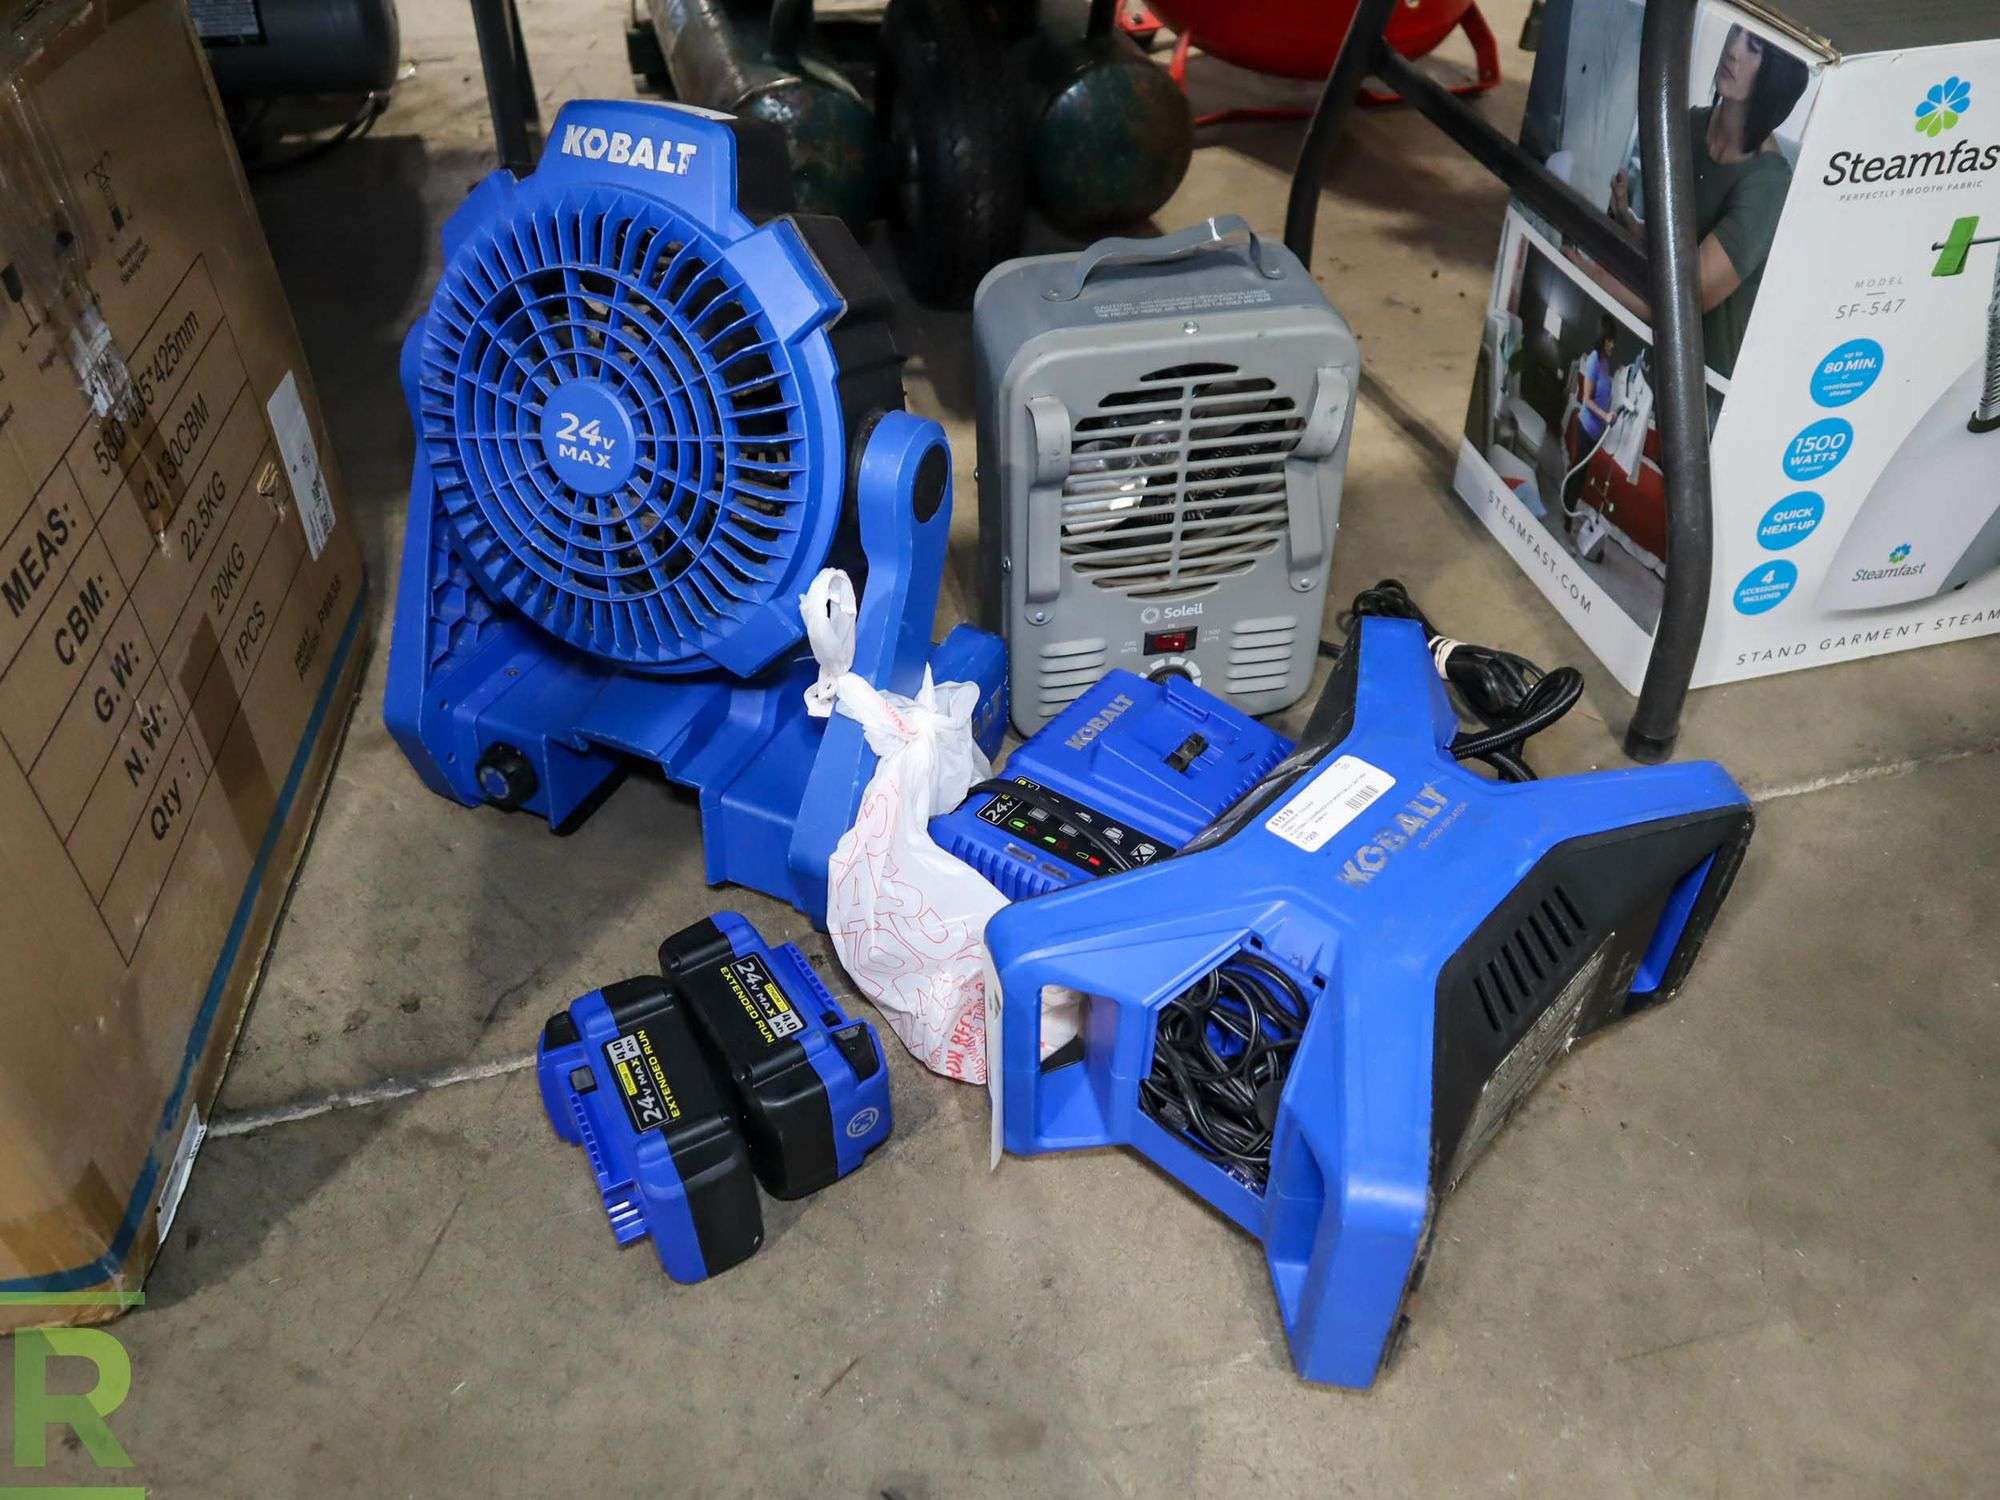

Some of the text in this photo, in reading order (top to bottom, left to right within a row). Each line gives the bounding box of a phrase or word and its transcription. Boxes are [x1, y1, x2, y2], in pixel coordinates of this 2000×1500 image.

[561, 124, 697, 175] KOBALT
[1839, 180, 1984, 202] PERFECTLY SMOOTH FABRIC
[1855, 277, 1904, 289] MODEL
[1835, 299, 1906, 319] SF-547
[1823, 357, 1877, 374] 80 MIN.
[1795, 433, 1846, 454] 1500
[559, 444, 612, 469] MAX
[1791, 452, 1838, 466] WATTS
[180, 470, 226, 561] 22.5KG
[1773, 507, 1815, 522] QUICK
[1761, 520, 1816, 536] HEAT-UP
[1, 503, 77, 618] MEAS:
[1488, 490, 1593, 614] STEAMFAST.COM
[211, 542, 245, 616] 20KG
[1761, 569, 1775, 583] 4
[1852, 562, 1926, 582] Steamfast
[54, 576, 110, 666] CBM:
[1163, 603, 1204, 619] Soleil
[233, 601, 267, 671] 1PCS
[1736, 643, 1806, 666] STAND
[1820, 622, 1923, 650] GARMENT
[1063, 693, 1135, 752] KOBALT
[1337, 784, 1449, 888] KOBALT
[720, 966, 776, 1043] EXTENDED RUN
[756, 993, 777, 1017] MAX
[782, 1013, 797, 1031] 4.0
[612, 1042, 626, 1060] 4.0
[631, 1057, 648, 1086] MAX
[637, 1030, 680, 1118] EXTENDED RUN
